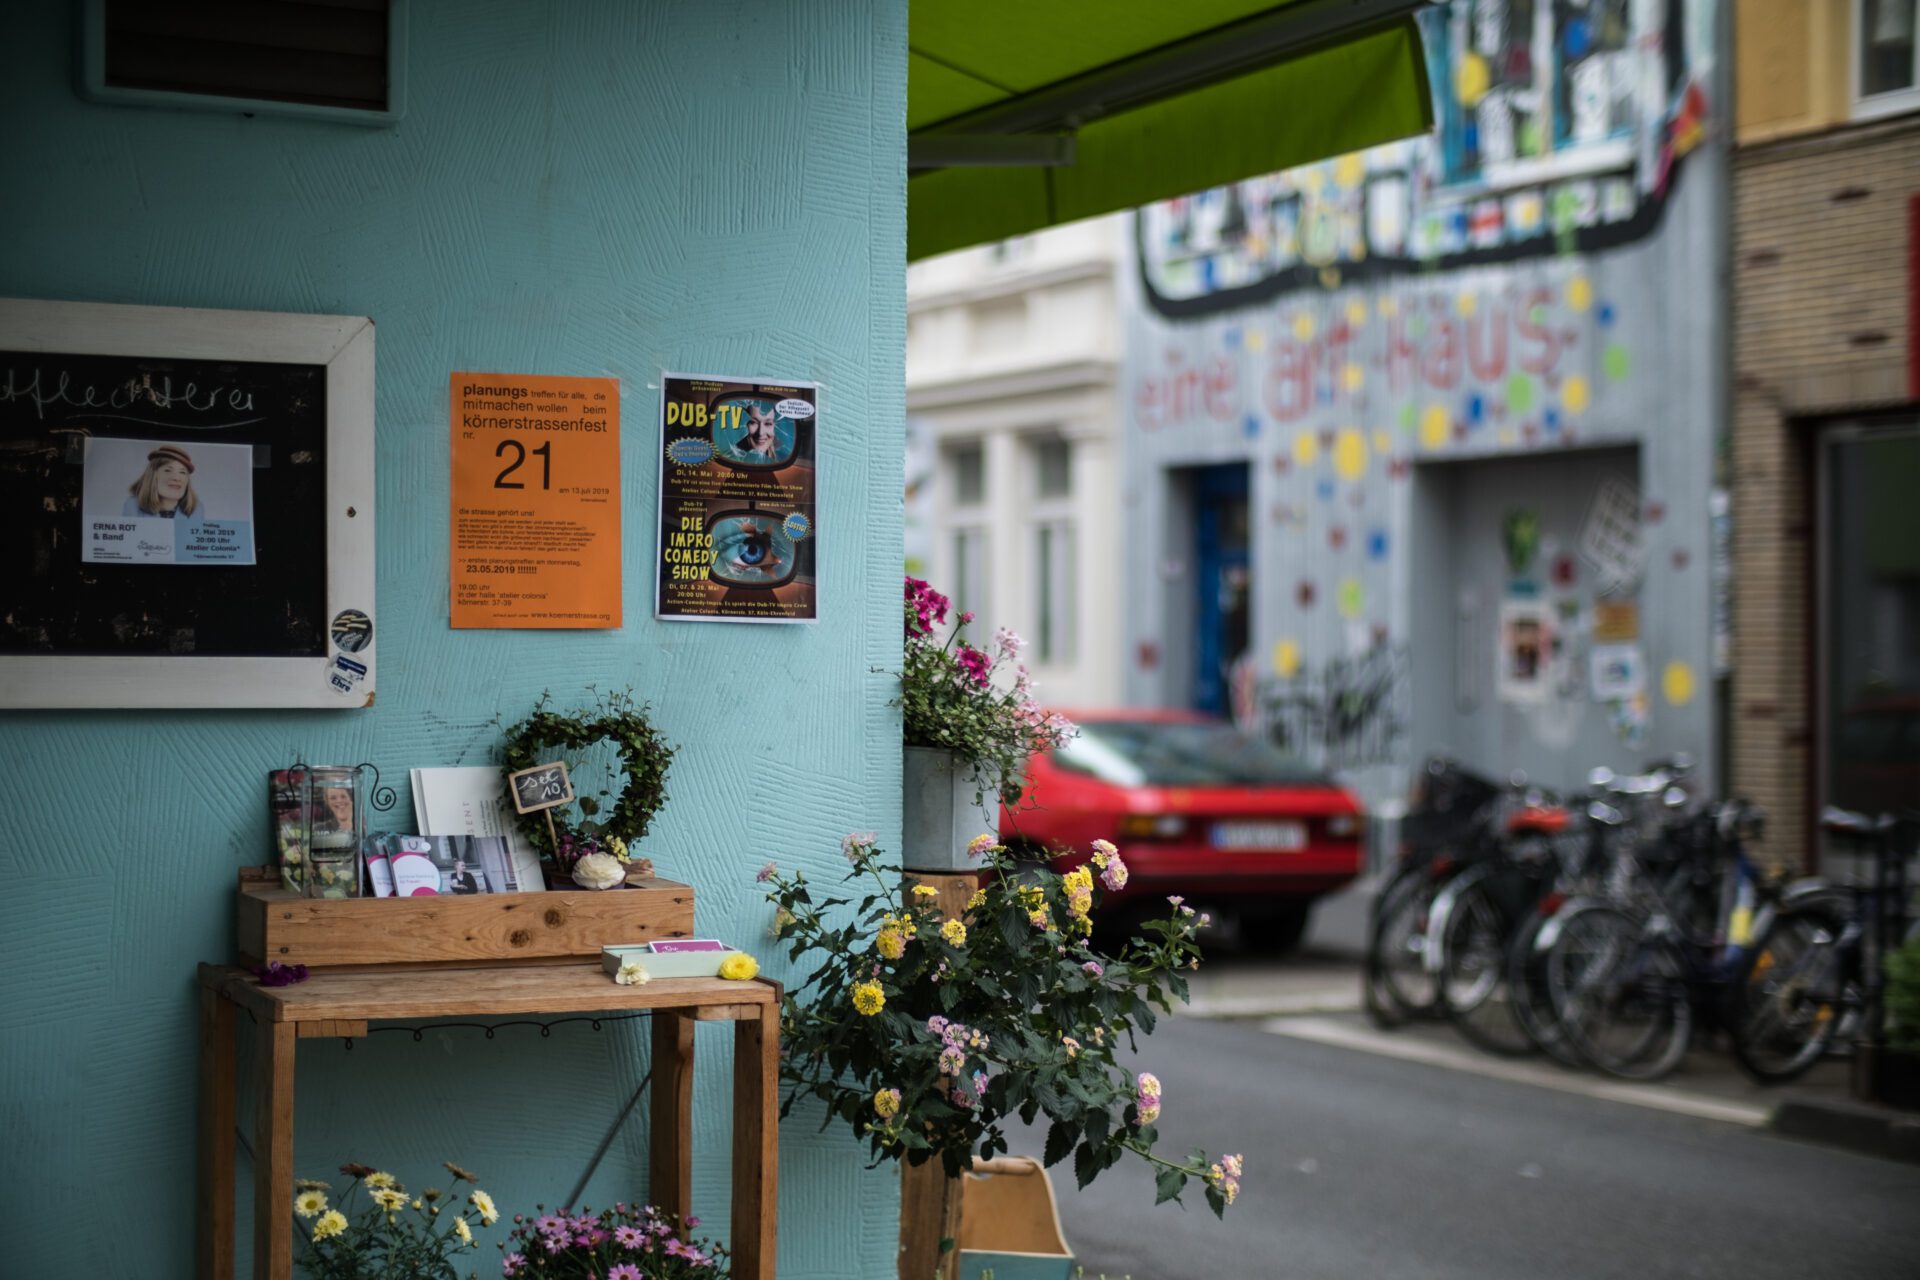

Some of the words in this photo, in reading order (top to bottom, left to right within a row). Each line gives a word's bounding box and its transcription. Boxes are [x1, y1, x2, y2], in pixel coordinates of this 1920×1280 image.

[463, 384, 528, 399] planungs
[558, 391, 569, 399] für
[463, 400, 533, 412] mitmachen
[537, 404, 567, 413] wollen
[583, 405, 606, 414] beim
[463, 414, 607, 432] körnerstrassenfest
[667, 401, 743, 430] DUB-TV
[463, 432, 475, 440] nr.
[494, 439, 550, 490] 21
[93, 523, 117, 531] ERNA
[681, 516, 703, 531] DIE
[102, 533, 124, 541] Band
[670, 533, 713, 547] IMPRO
[664, 548, 718, 564] COMEDY
[466, 565, 515, 574] 23.05.2019
[672, 565, 711, 580] SHOW
